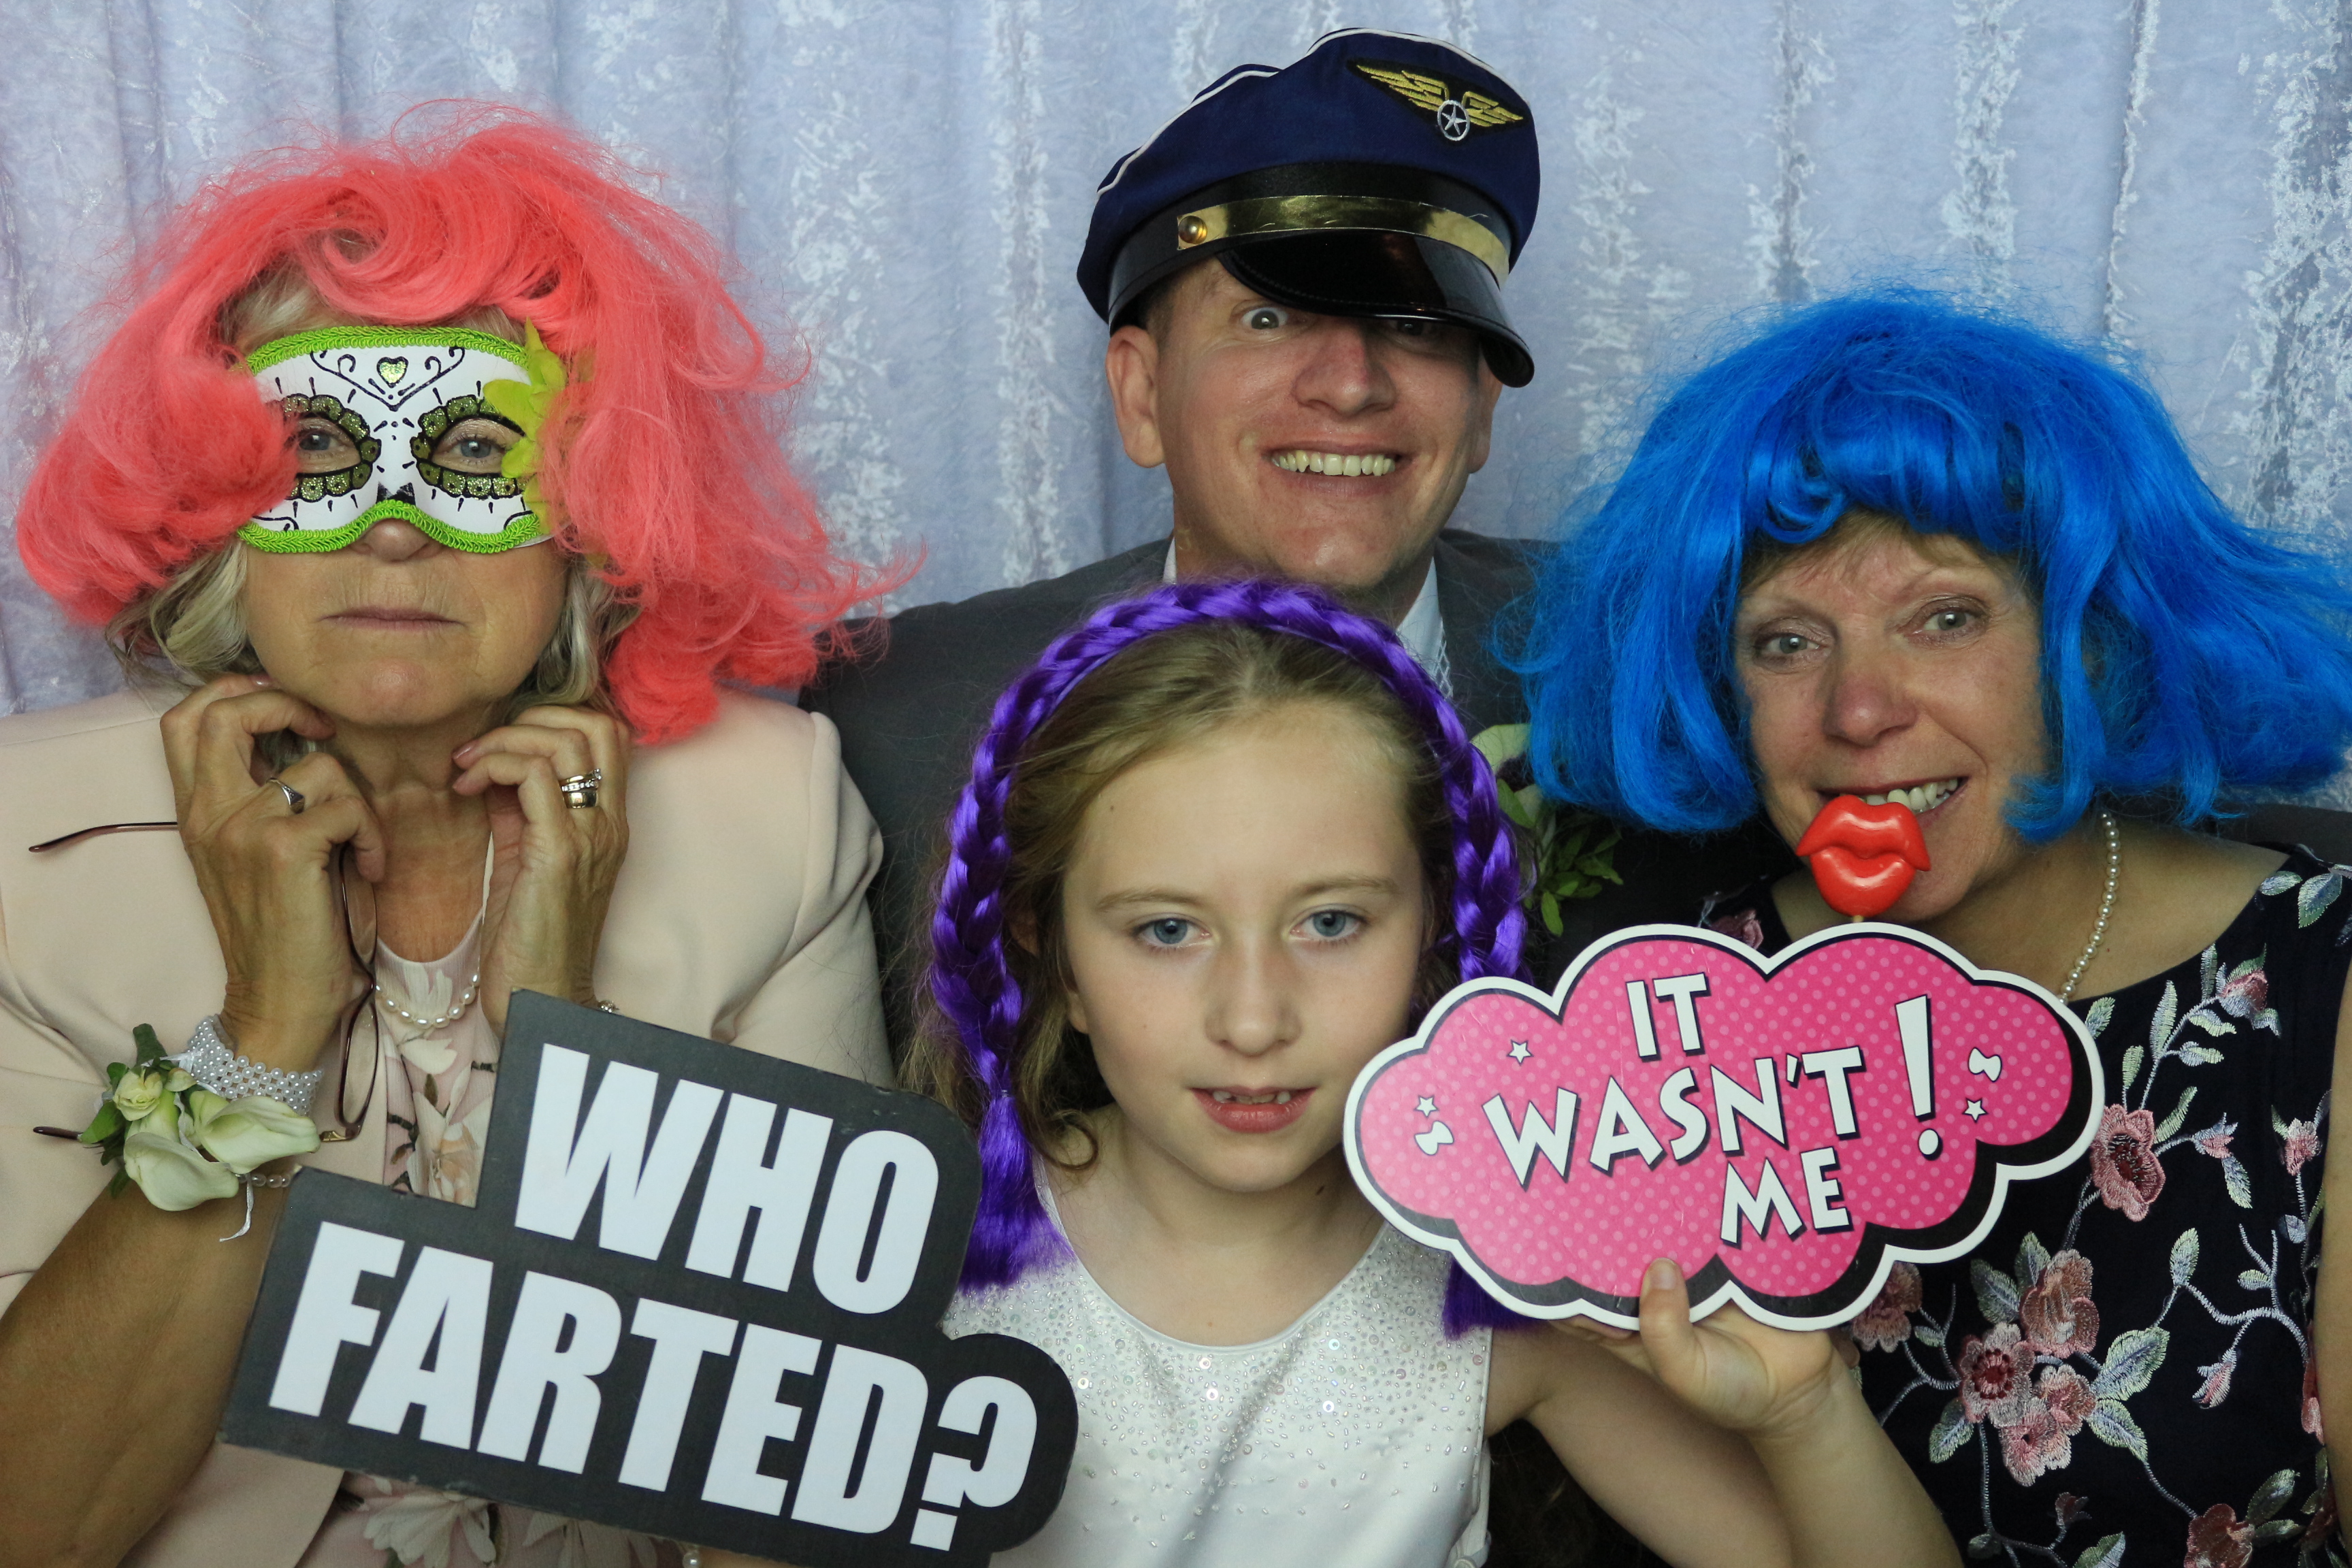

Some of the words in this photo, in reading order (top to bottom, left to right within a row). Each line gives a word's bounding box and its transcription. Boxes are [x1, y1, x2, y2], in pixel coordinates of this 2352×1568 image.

[1626, 973, 1709, 1060] IT
[514, 1043, 940, 1315] WHO
[1482, 1045, 1864, 1190] WASN'T
[1720, 1146, 1852, 1248] ME
[268, 1220, 1039, 1552] FARTED?
